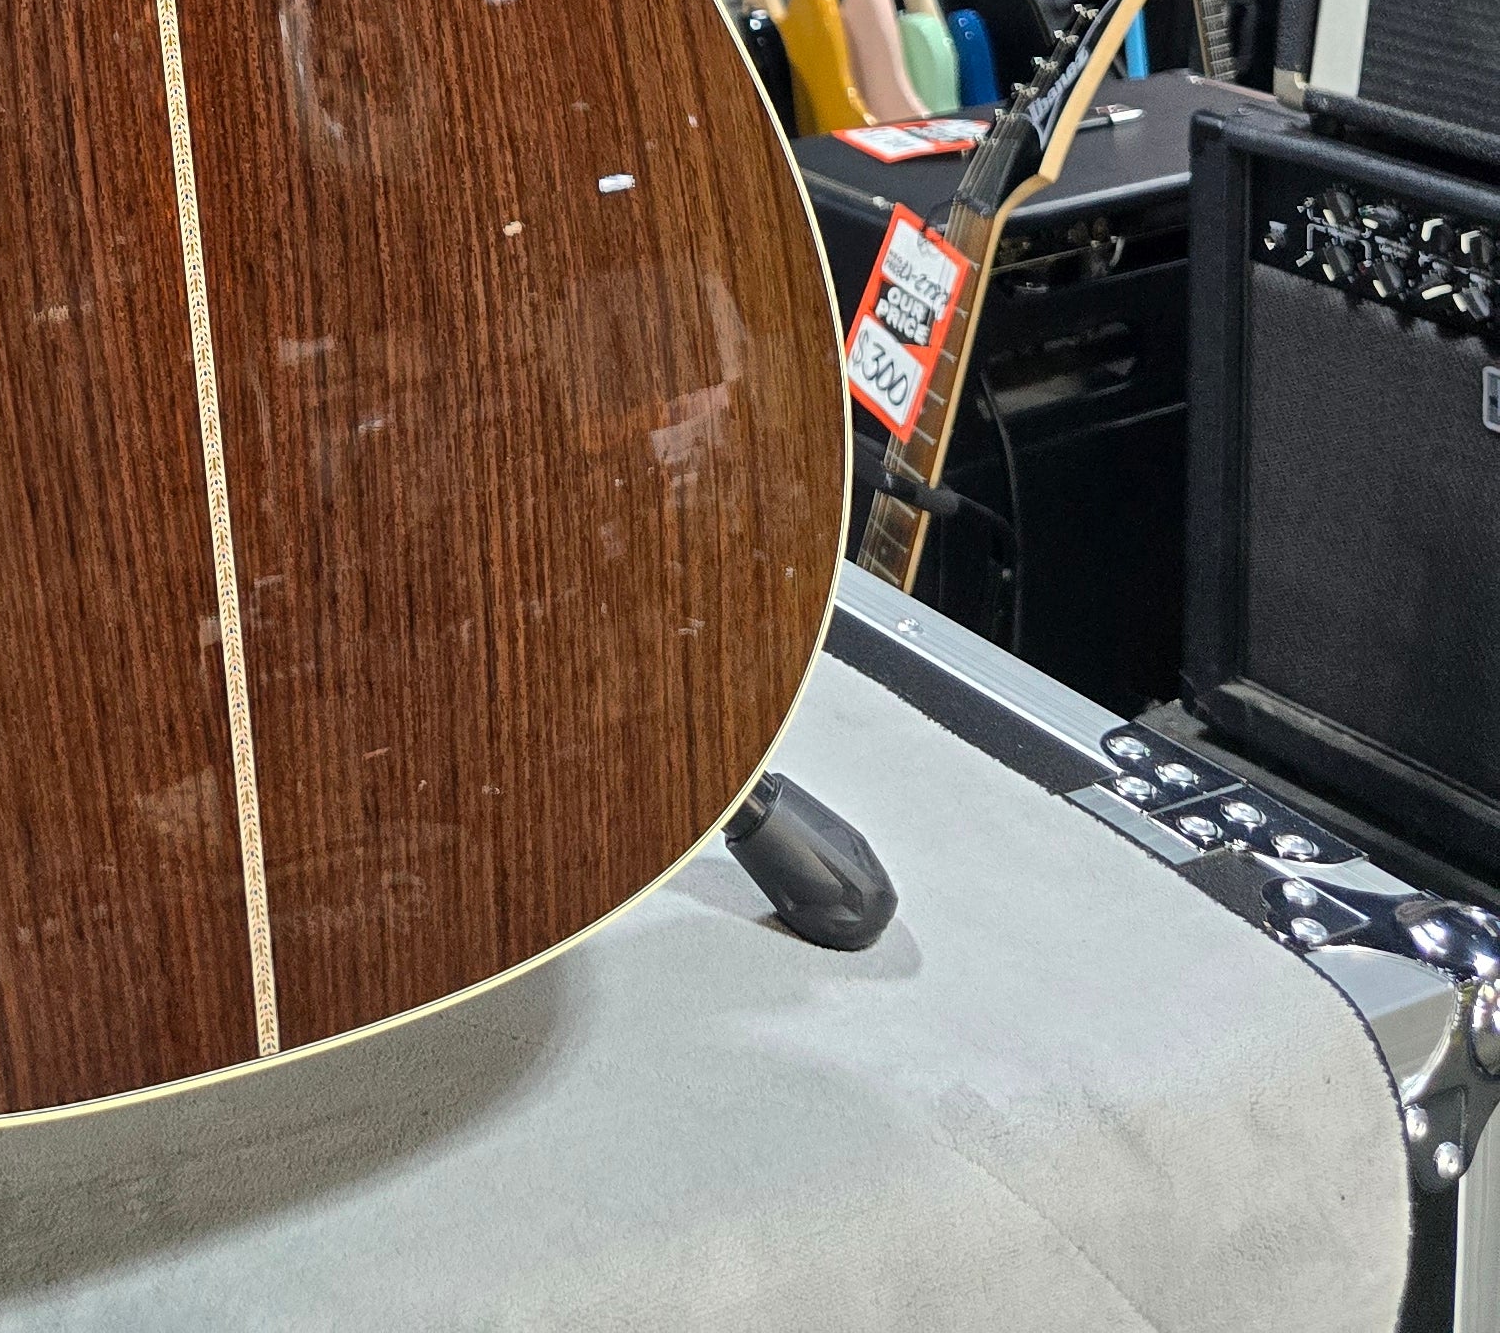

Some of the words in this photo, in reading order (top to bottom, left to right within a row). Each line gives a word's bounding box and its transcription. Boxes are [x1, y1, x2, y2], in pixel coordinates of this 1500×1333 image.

[875, 297, 931, 346] PRICE
[887, 285, 929, 323] OUR
[851, 329, 909, 406] $300
